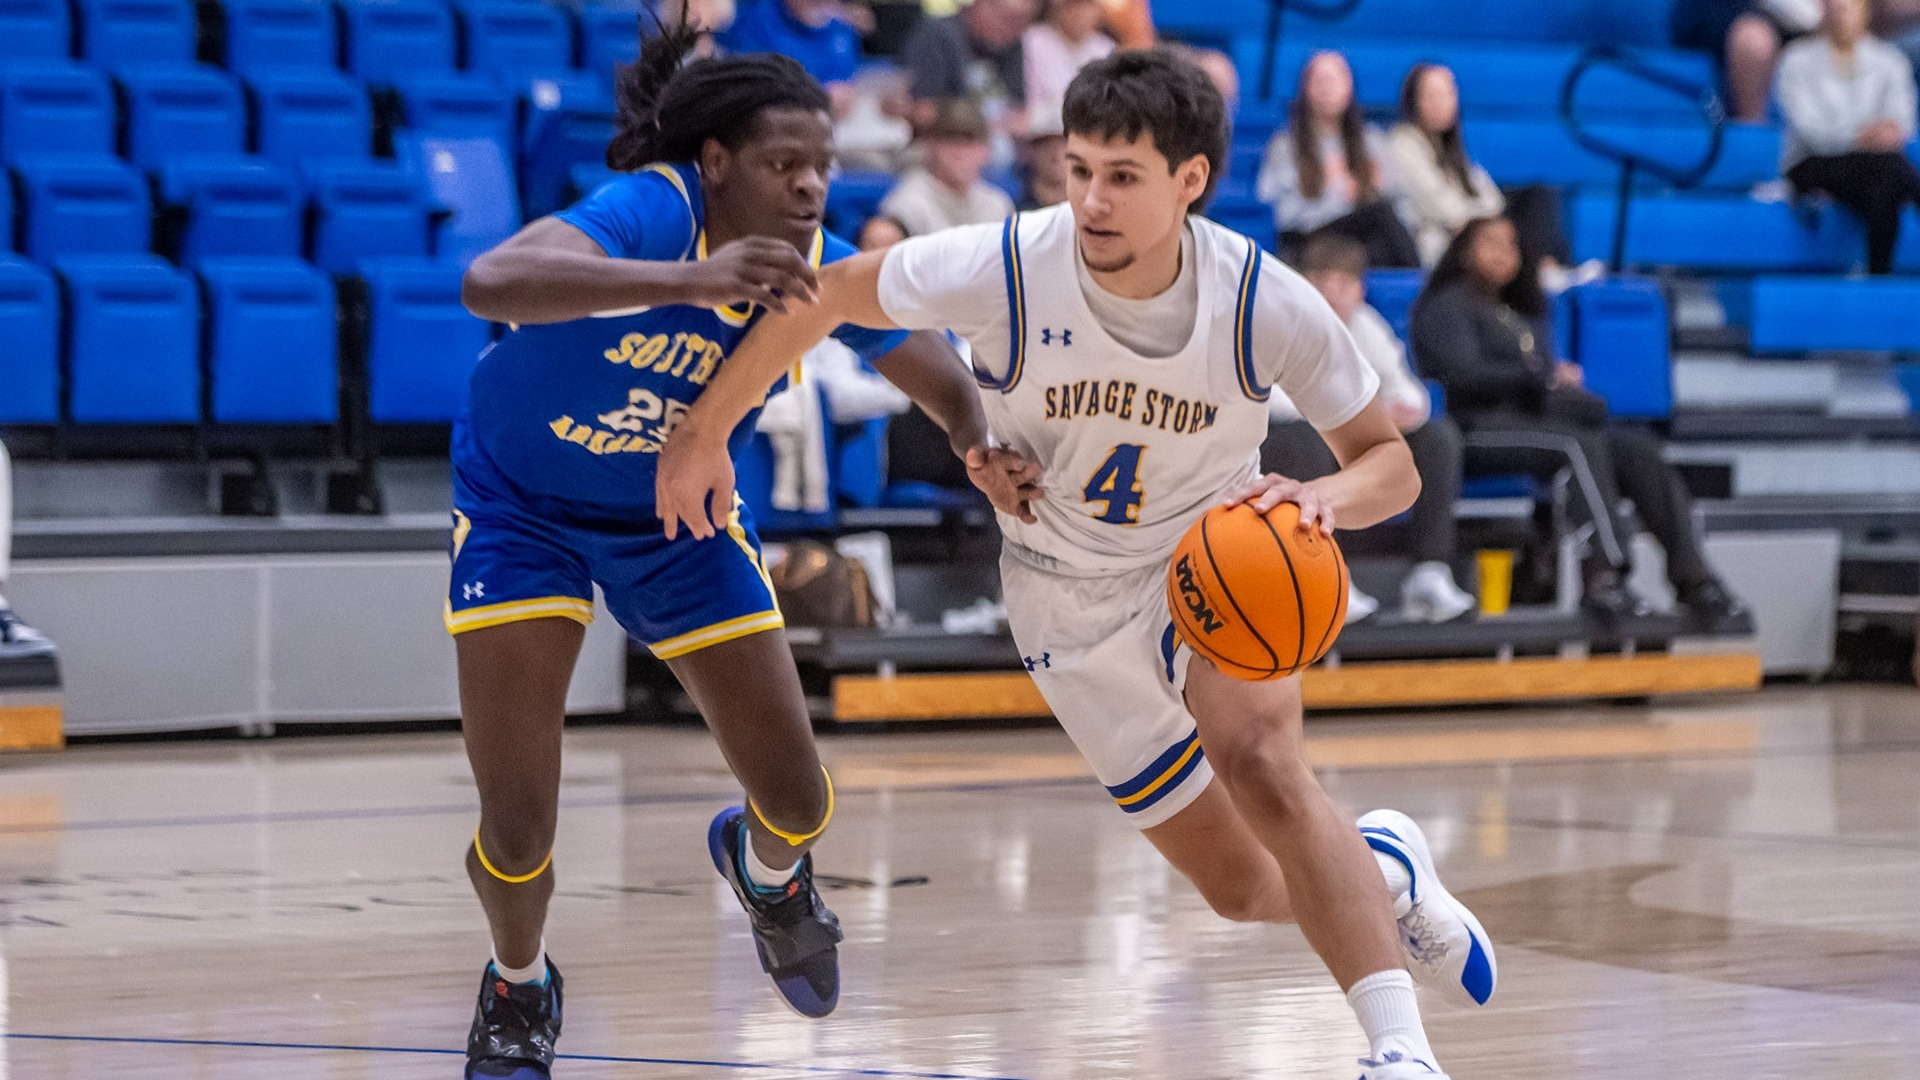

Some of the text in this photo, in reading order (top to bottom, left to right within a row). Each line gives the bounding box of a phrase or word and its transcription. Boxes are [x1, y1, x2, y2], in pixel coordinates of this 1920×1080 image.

[1044, 380, 1219, 434] SAVAGE STORM
[1081, 443, 1149, 527] 4
[1176, 552, 1224, 635] NCAA
